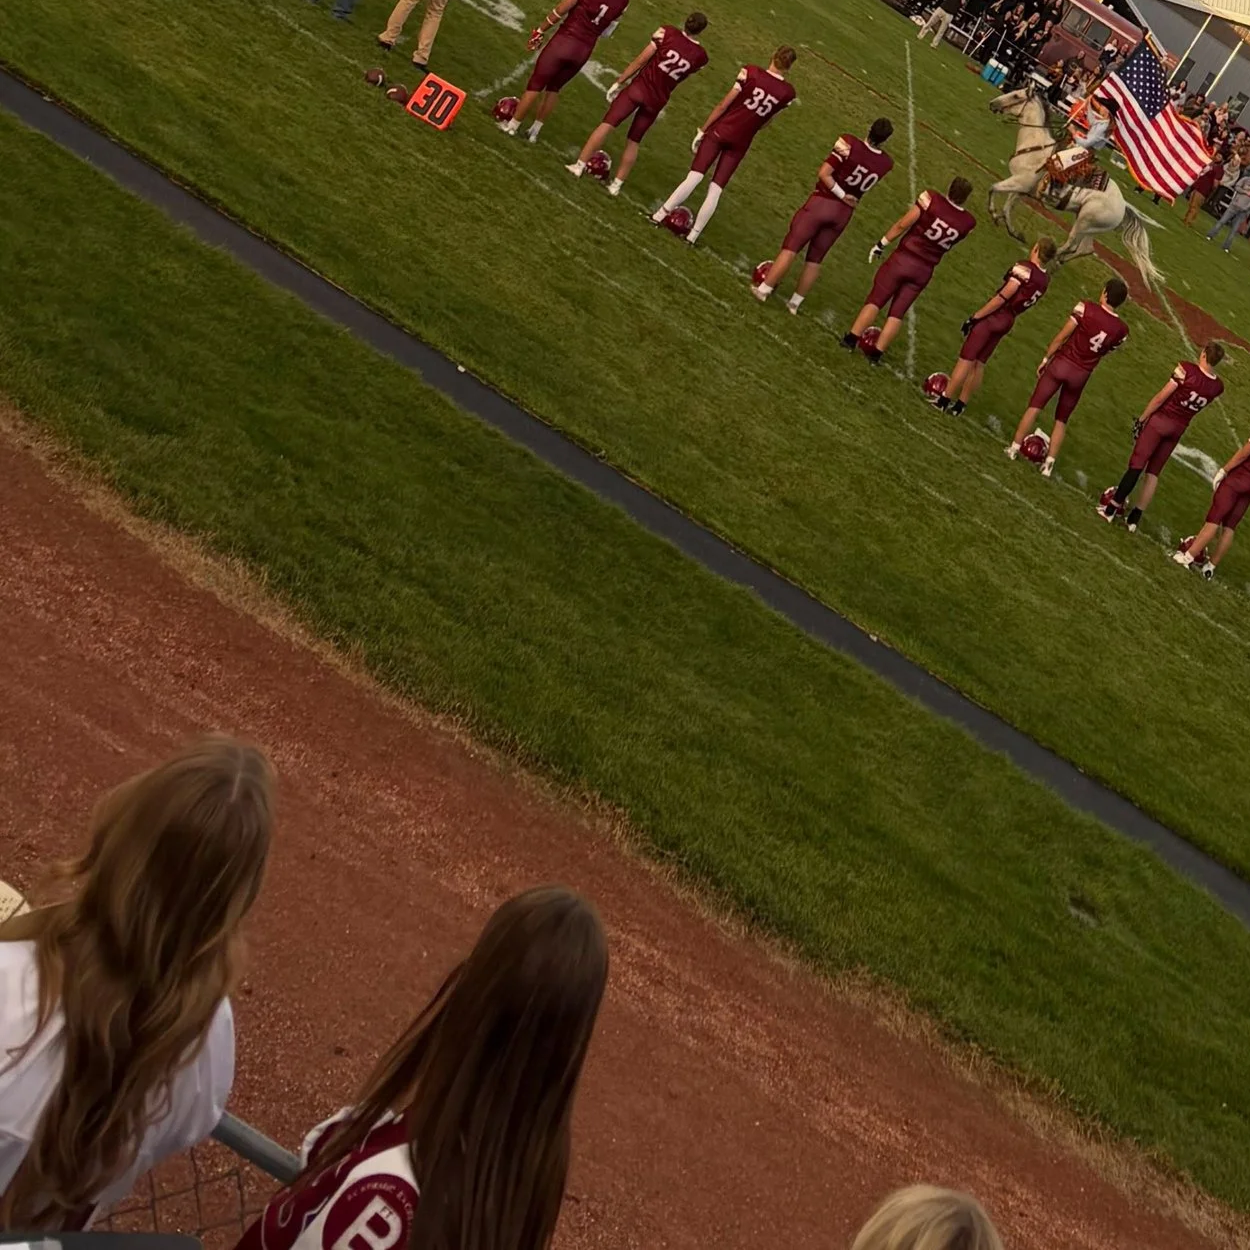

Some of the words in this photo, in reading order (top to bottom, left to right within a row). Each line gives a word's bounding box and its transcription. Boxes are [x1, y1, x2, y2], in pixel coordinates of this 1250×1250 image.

[591, 4, 609, 26] 1
[657, 49, 691, 81] 22
[411, 79, 457, 126] 30
[743, 87, 779, 117] 35
[844, 164, 879, 192] 50
[923, 217, 959, 250] 52
[1088, 330, 1107, 353] 4
